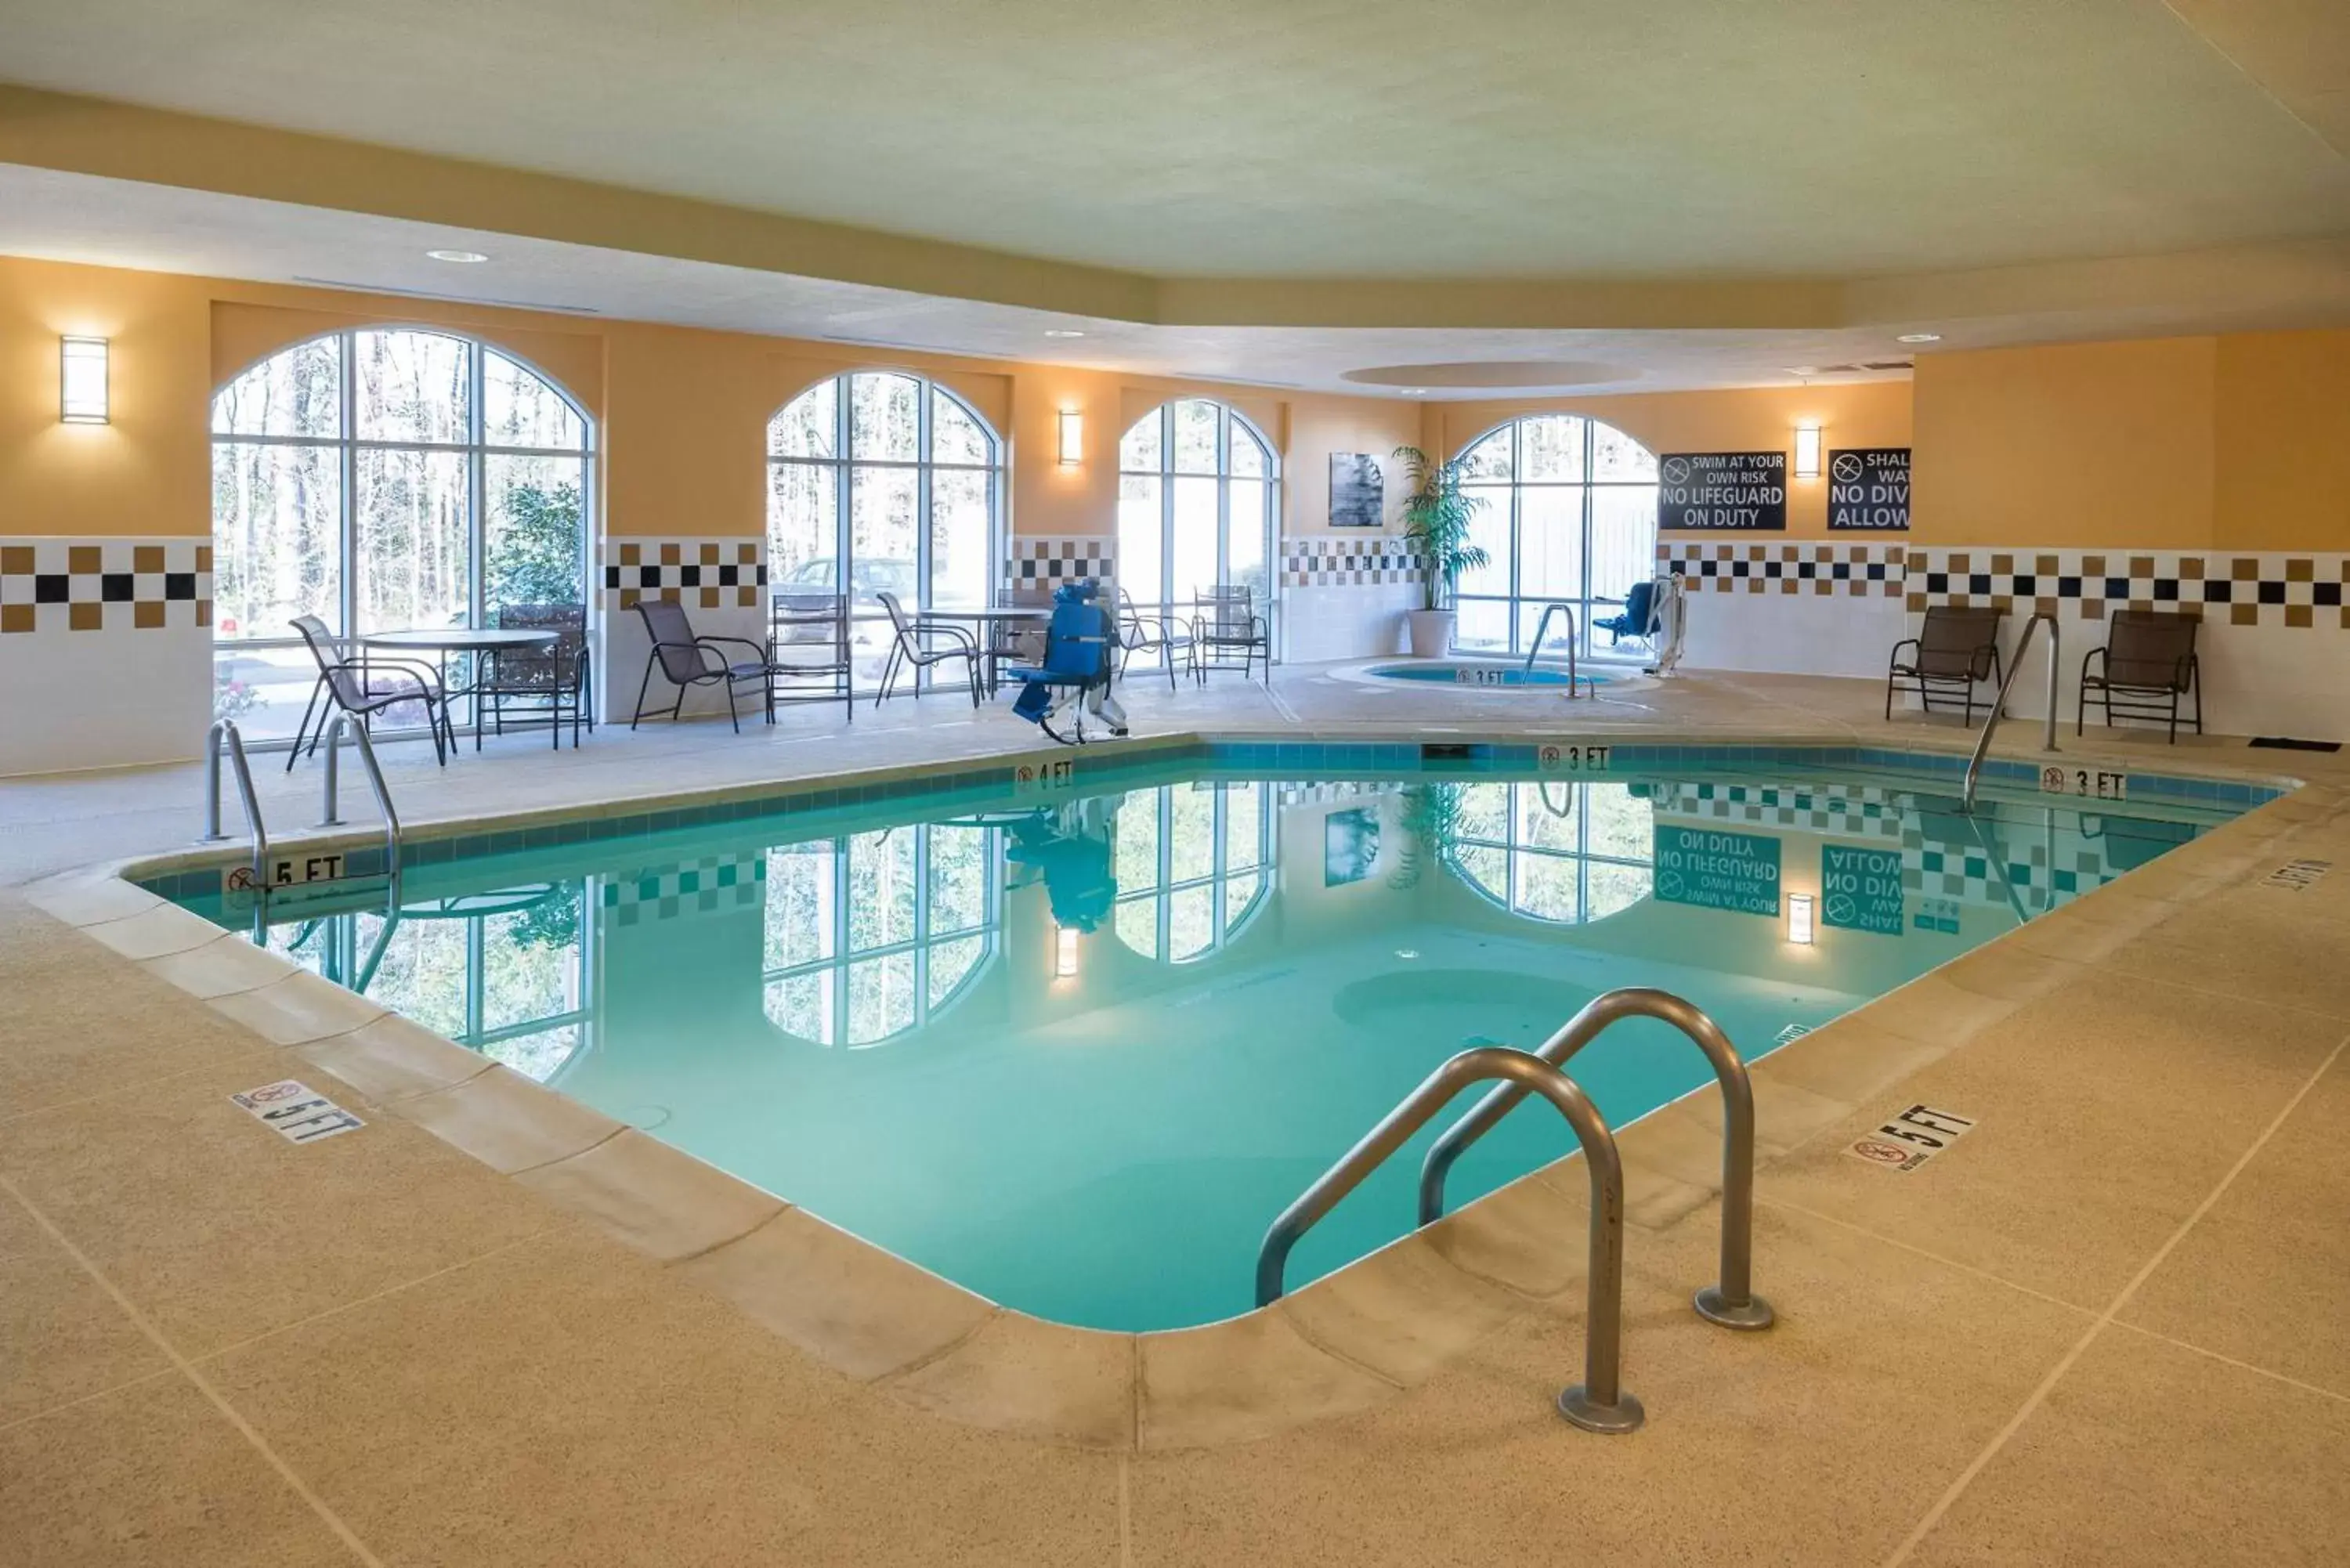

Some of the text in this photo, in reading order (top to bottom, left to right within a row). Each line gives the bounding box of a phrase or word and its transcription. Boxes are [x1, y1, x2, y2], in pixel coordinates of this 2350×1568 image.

[1692, 455, 1784, 469] SWIM AT YOUR
[1867, 453, 1909, 467] SHAL
[1706, 471, 1768, 484] OWN RISK
[1878, 470, 1910, 482] WA
[1662, 486, 1783, 505] NO LIFEGUARD
[1832, 485, 1909, 504] NO DIV
[1684, 508, 1759, 526] ON DUTY
[1587, 746, 1607, 761] FT
[1054, 761, 1072, 778] FT
[277, 856, 341, 884] 5 FT
[263, 1099, 328, 1119] 5
[280, 1108, 361, 1140] FT
[1879, 1104, 1972, 1148] 5 FT
